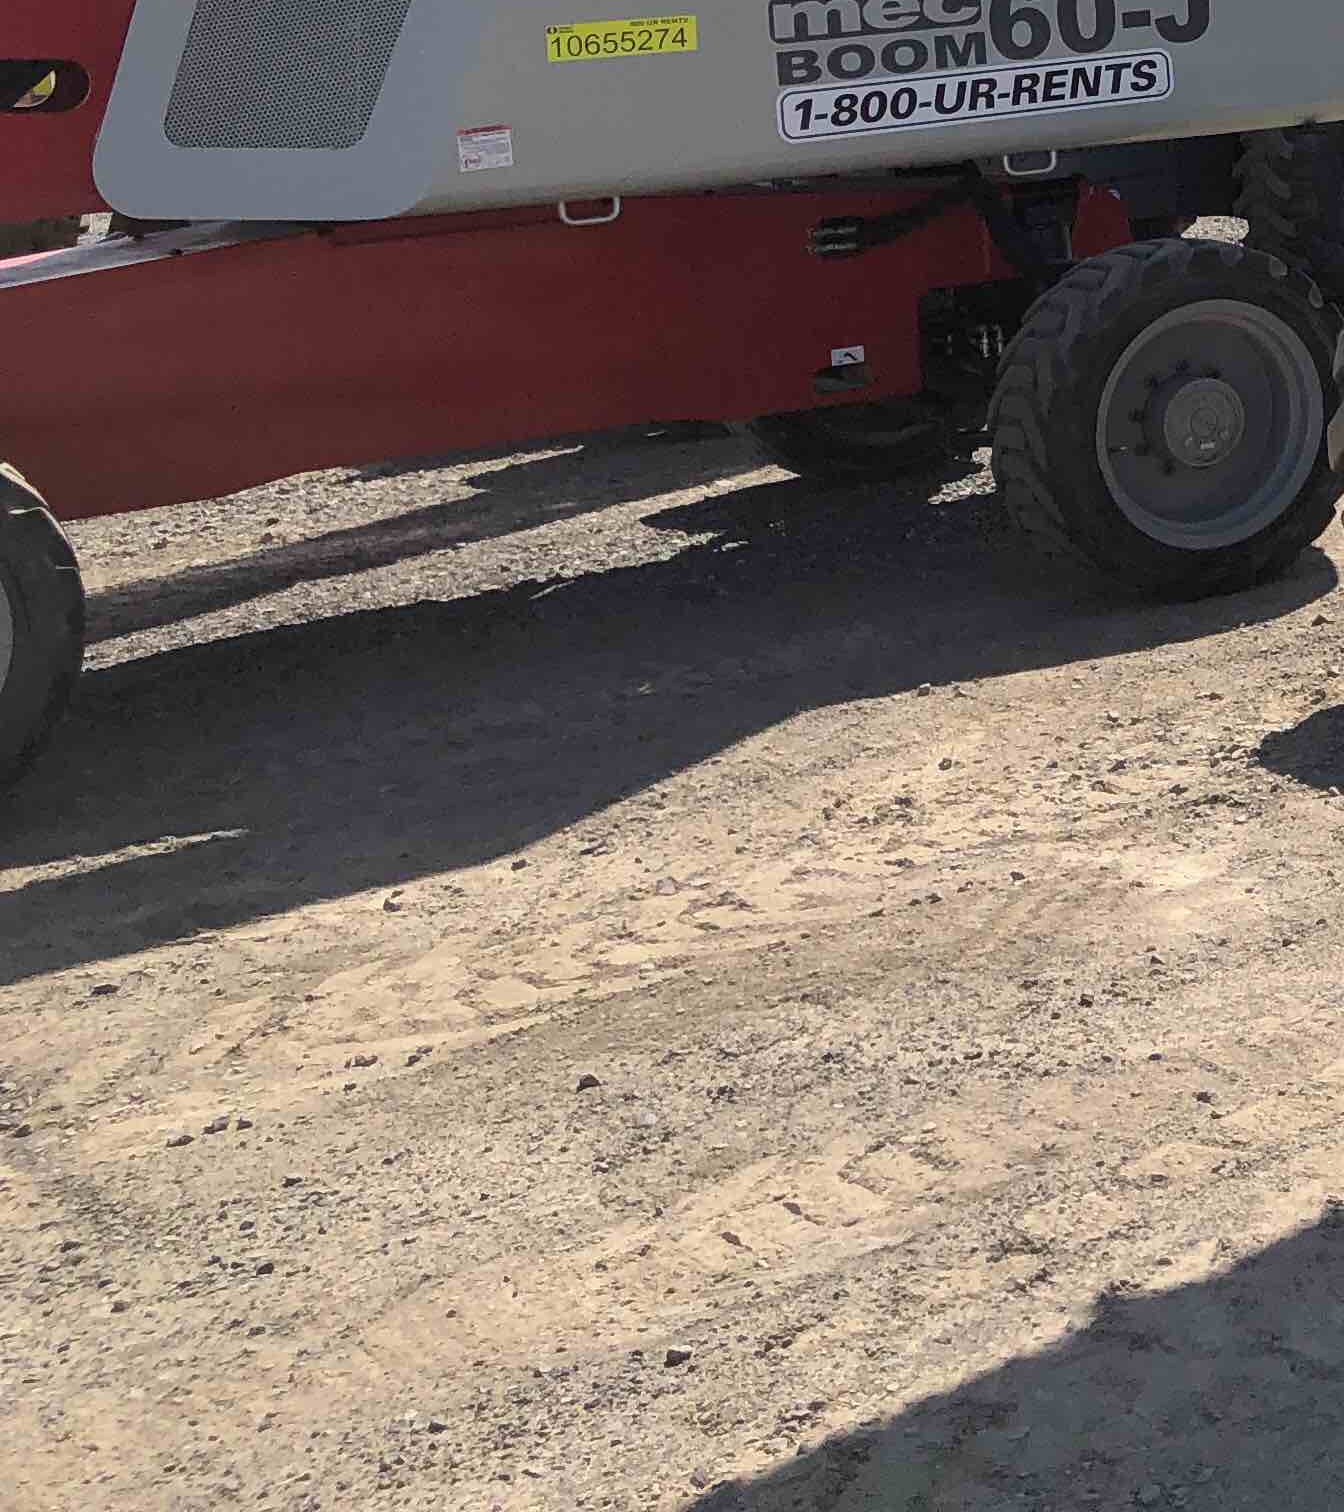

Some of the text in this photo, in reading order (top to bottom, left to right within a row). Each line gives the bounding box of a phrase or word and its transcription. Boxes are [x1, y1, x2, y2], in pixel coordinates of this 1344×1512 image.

[551, 27, 688, 58] 10655274
[776, 31, 987, 86] BOOM
[794, 59, 1158, 131] 1-800-UR-RENTS
